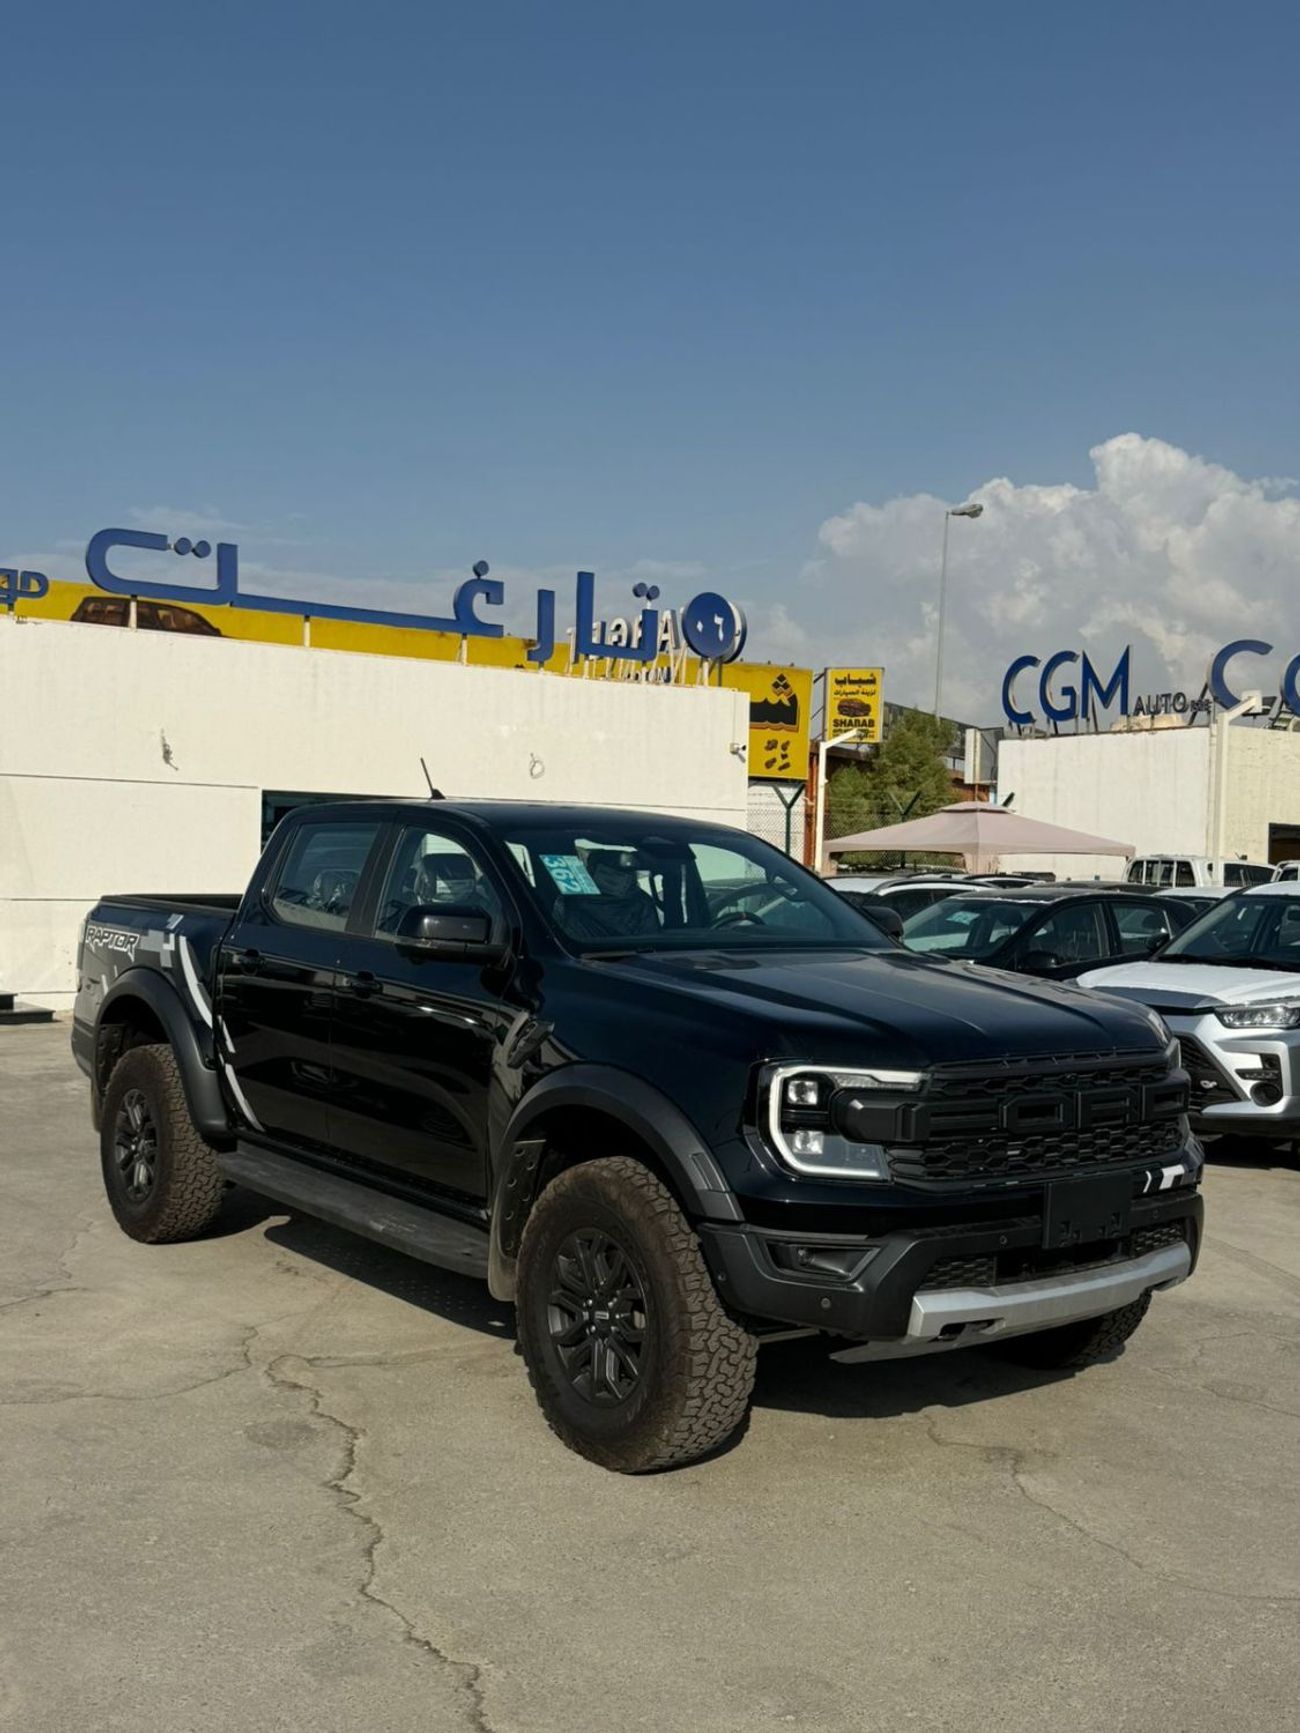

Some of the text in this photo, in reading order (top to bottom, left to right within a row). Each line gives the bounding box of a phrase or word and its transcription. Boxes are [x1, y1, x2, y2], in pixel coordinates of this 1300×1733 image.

[1002, 645, 1187, 724] CGM AUTO
[543, 856, 581, 893] 362
[85, 925, 139, 962] RAPTOR
